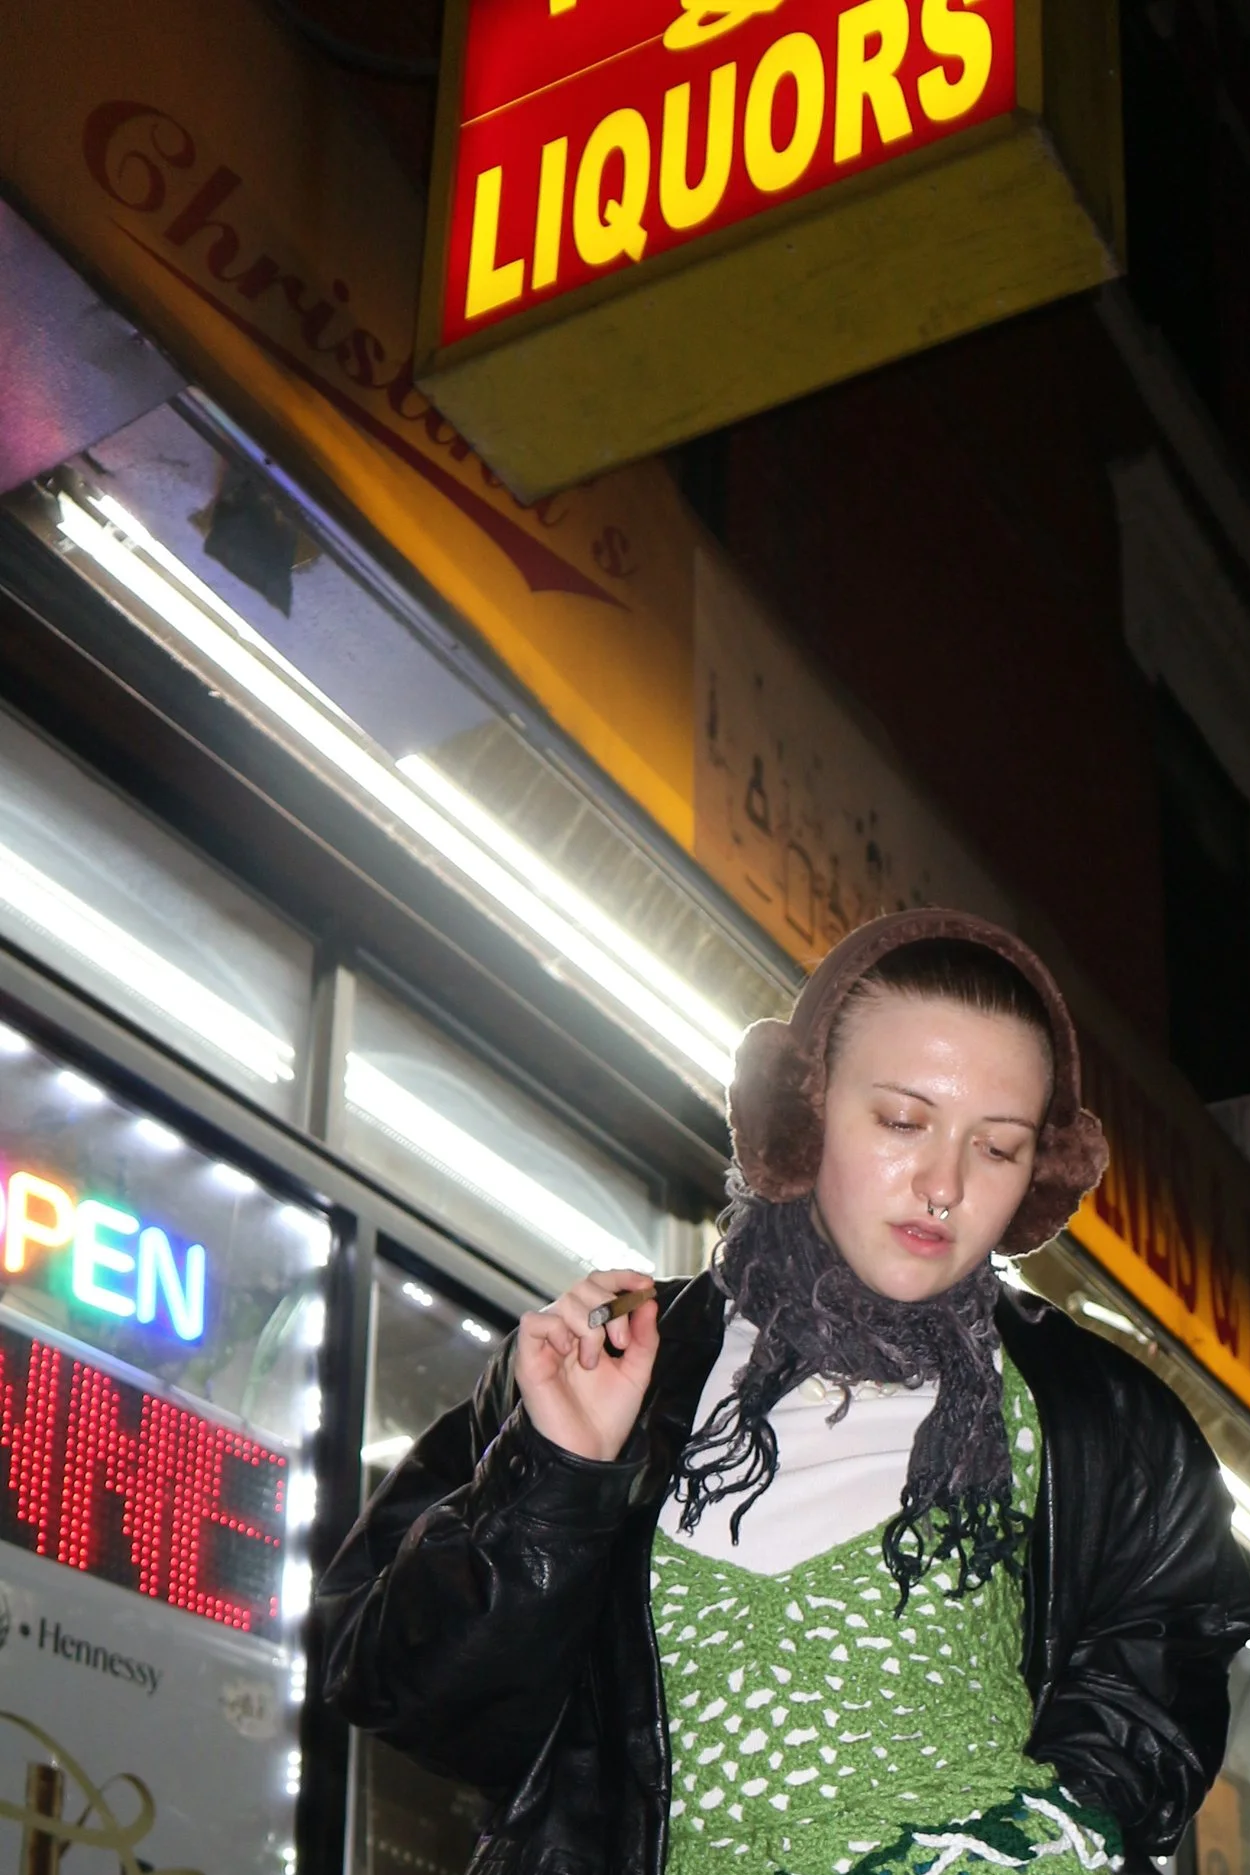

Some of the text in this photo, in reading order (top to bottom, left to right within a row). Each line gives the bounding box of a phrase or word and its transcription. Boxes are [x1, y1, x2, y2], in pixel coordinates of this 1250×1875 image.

[465, 0, 993, 320] LIQUORS
[0, 1170, 206, 1341] PEN
[38, 1616, 163, 1695] Hennessy
